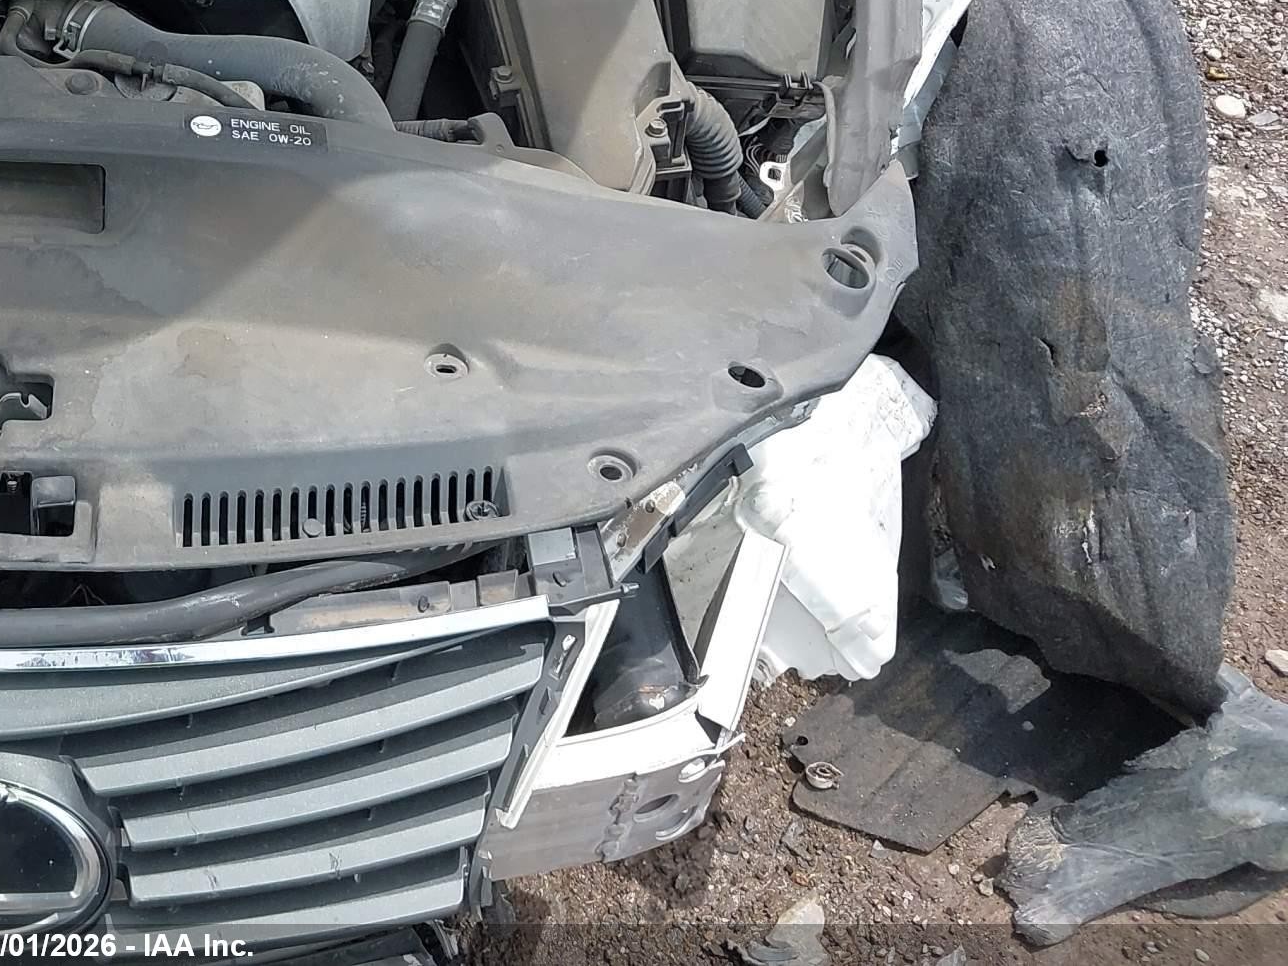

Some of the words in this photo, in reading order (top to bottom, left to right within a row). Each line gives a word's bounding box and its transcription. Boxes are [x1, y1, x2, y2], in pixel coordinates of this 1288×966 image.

[230, 118, 280, 132] ENGINE
[289, 124, 311, 135] OIL
[231, 130, 260, 141] SAE
[268, 133, 312, 146] 0W-20
